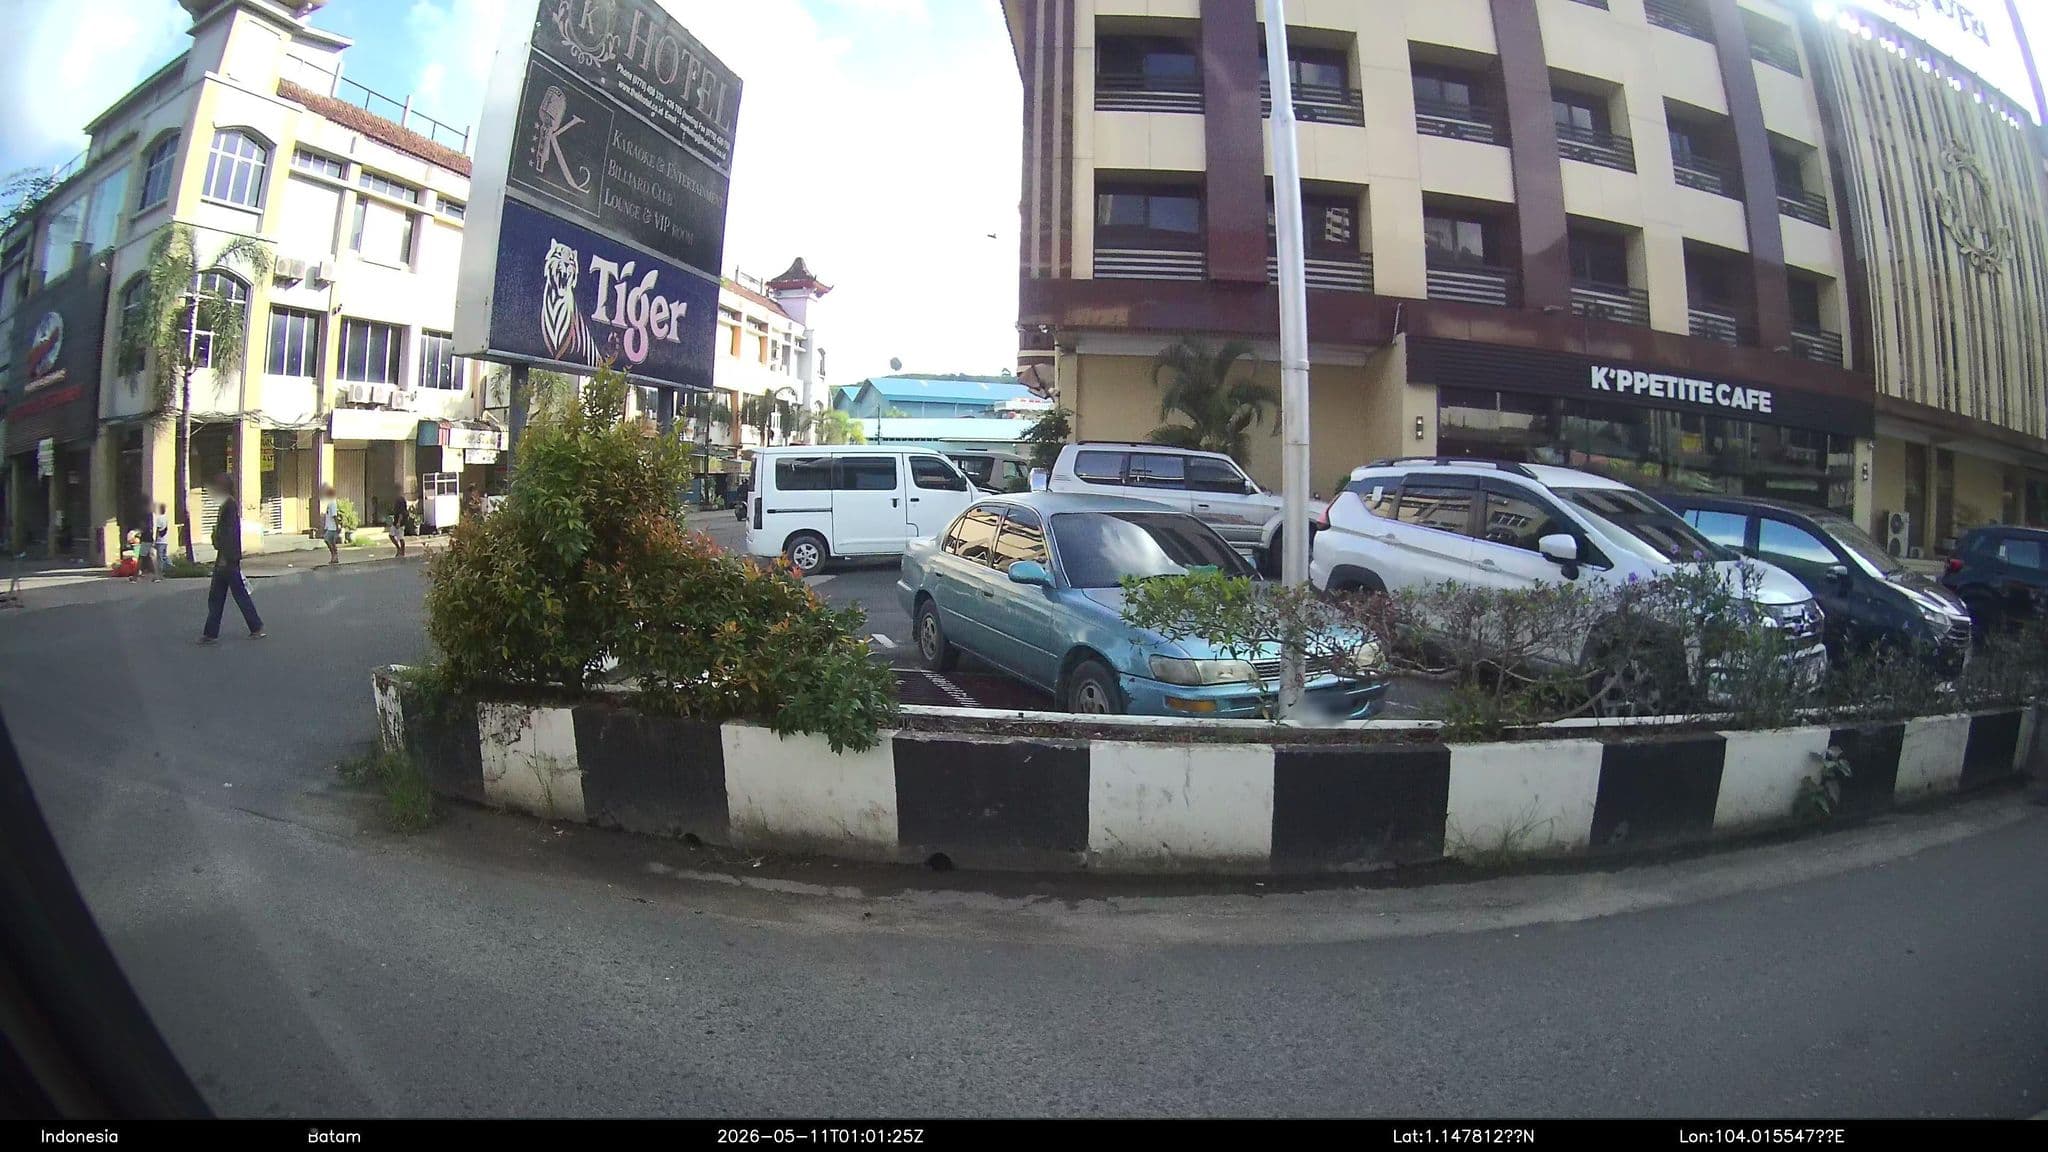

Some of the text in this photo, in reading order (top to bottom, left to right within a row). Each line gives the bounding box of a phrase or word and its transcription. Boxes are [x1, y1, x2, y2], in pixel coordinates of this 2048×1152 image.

[616, 63, 633, 80] Phone
[624, 9, 730, 133] HOTEL
[612, 129, 655, 169] KARAOKE
[656, 157, 665, 173] &
[607, 159, 649, 194] BILLIARD
[603, 187, 640, 219] LOUNGE
[642, 207, 652, 224] &
[654, 211, 671, 232] VIP
[589, 254, 687, 364] Tiger
[1591, 366, 1772, 413] K'PPETITE CAFE
